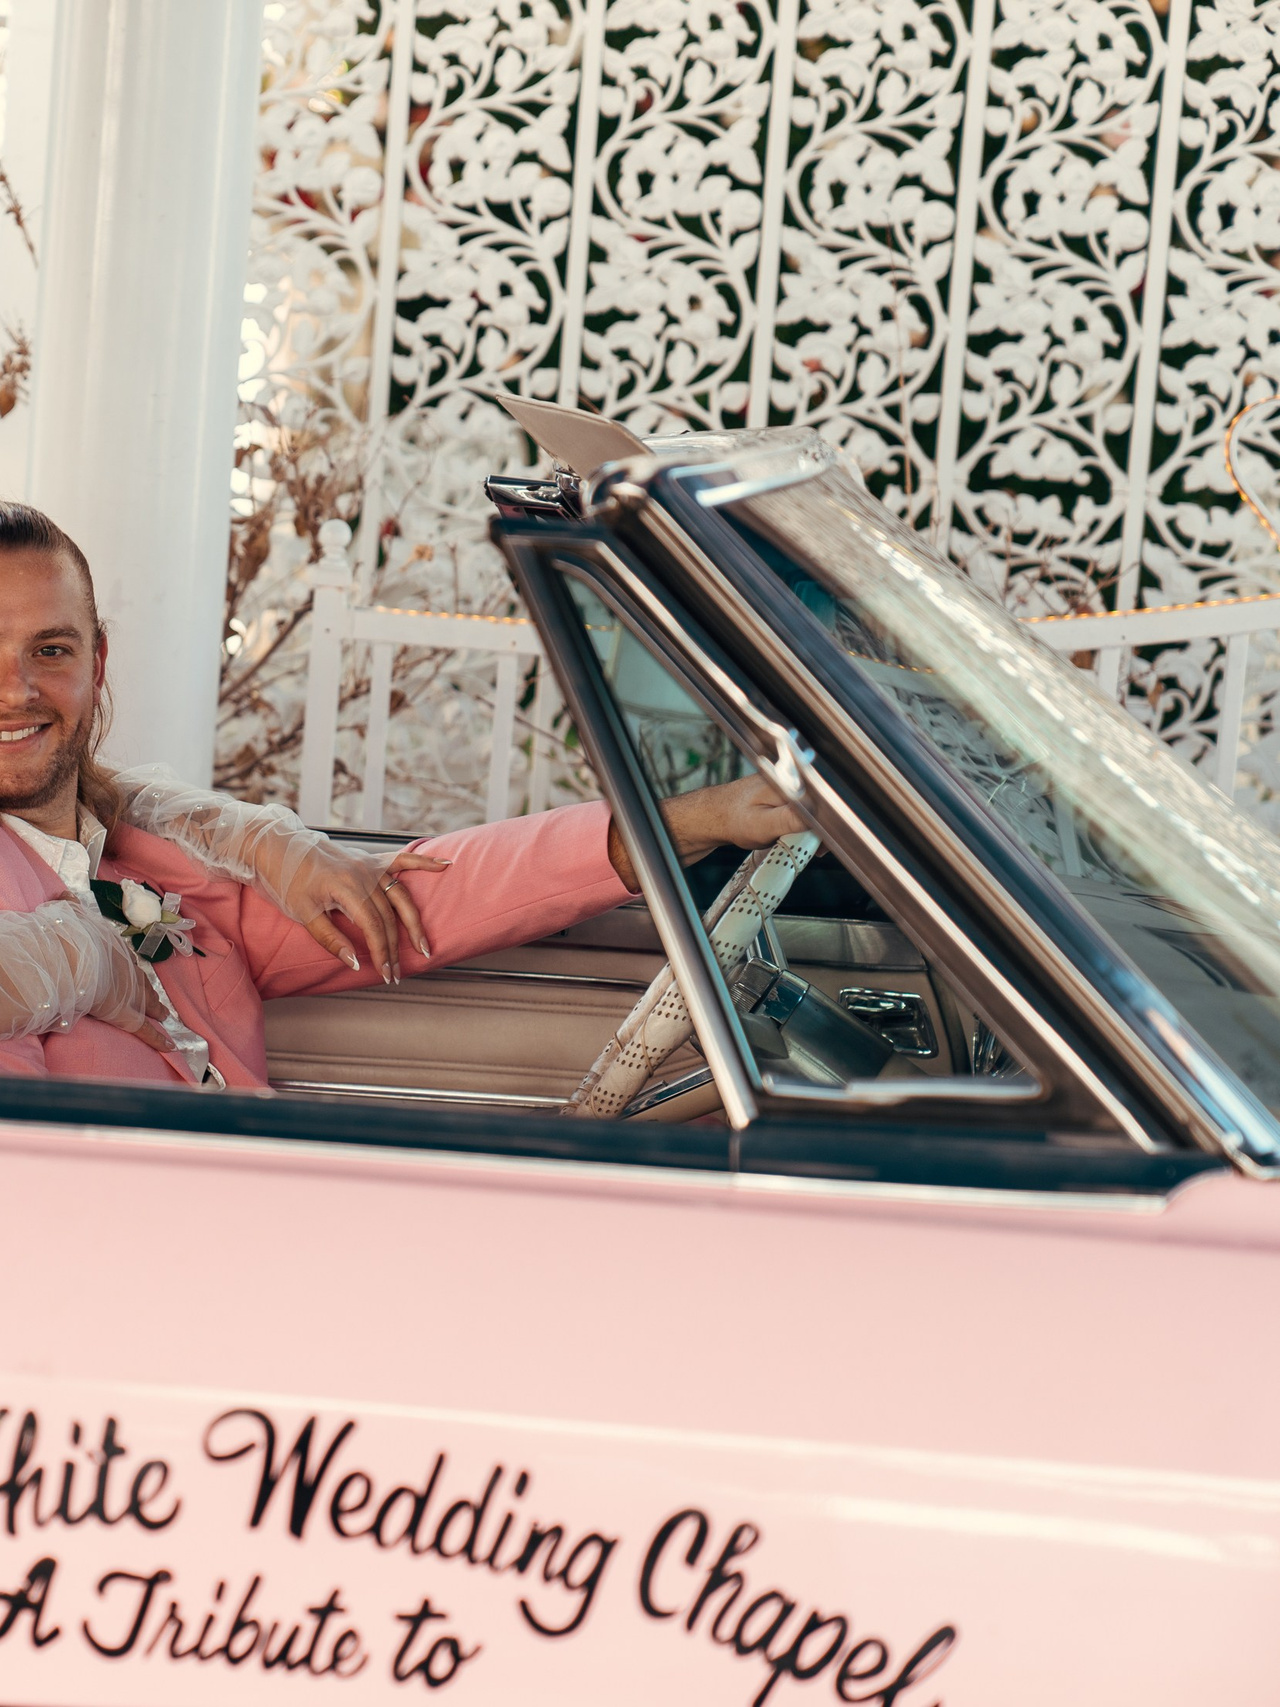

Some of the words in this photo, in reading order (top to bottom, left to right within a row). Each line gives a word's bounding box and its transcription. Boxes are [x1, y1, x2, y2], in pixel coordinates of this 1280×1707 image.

[81, 1569, 369, 1678] Tribute
[391, 1598, 482, 1690] to
[202, 1407, 620, 1640] Wedding
[637, 1508, 957, 1707] Chapel
